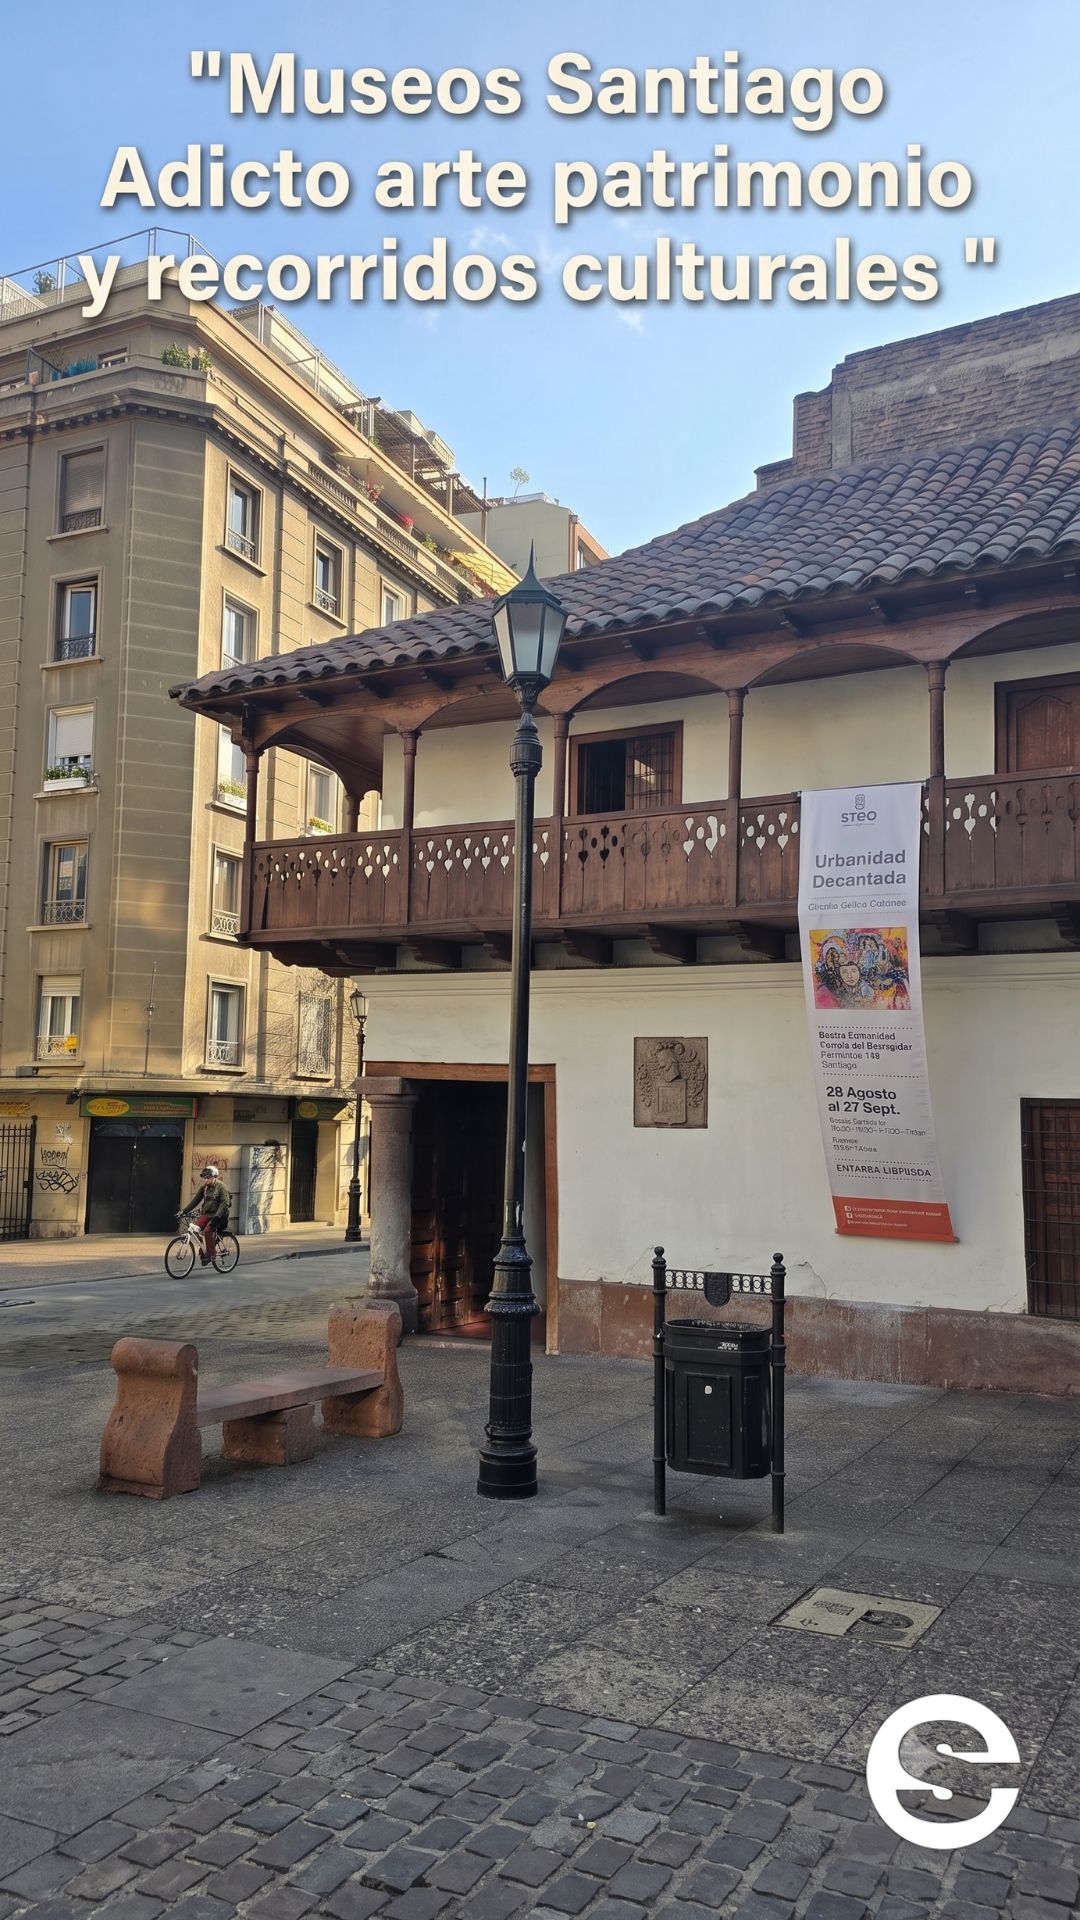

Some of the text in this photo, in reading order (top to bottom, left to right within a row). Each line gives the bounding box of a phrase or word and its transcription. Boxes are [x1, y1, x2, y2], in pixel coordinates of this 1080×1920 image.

[815, 849, 906, 868] Urbanidad
[813, 870, 906, 888] Decantada
[822, 1061, 857, 1070] Santiago
[826, 1086, 897, 1101] 28 Agosto
[828, 1101, 900, 1117] al 27 Sept.
